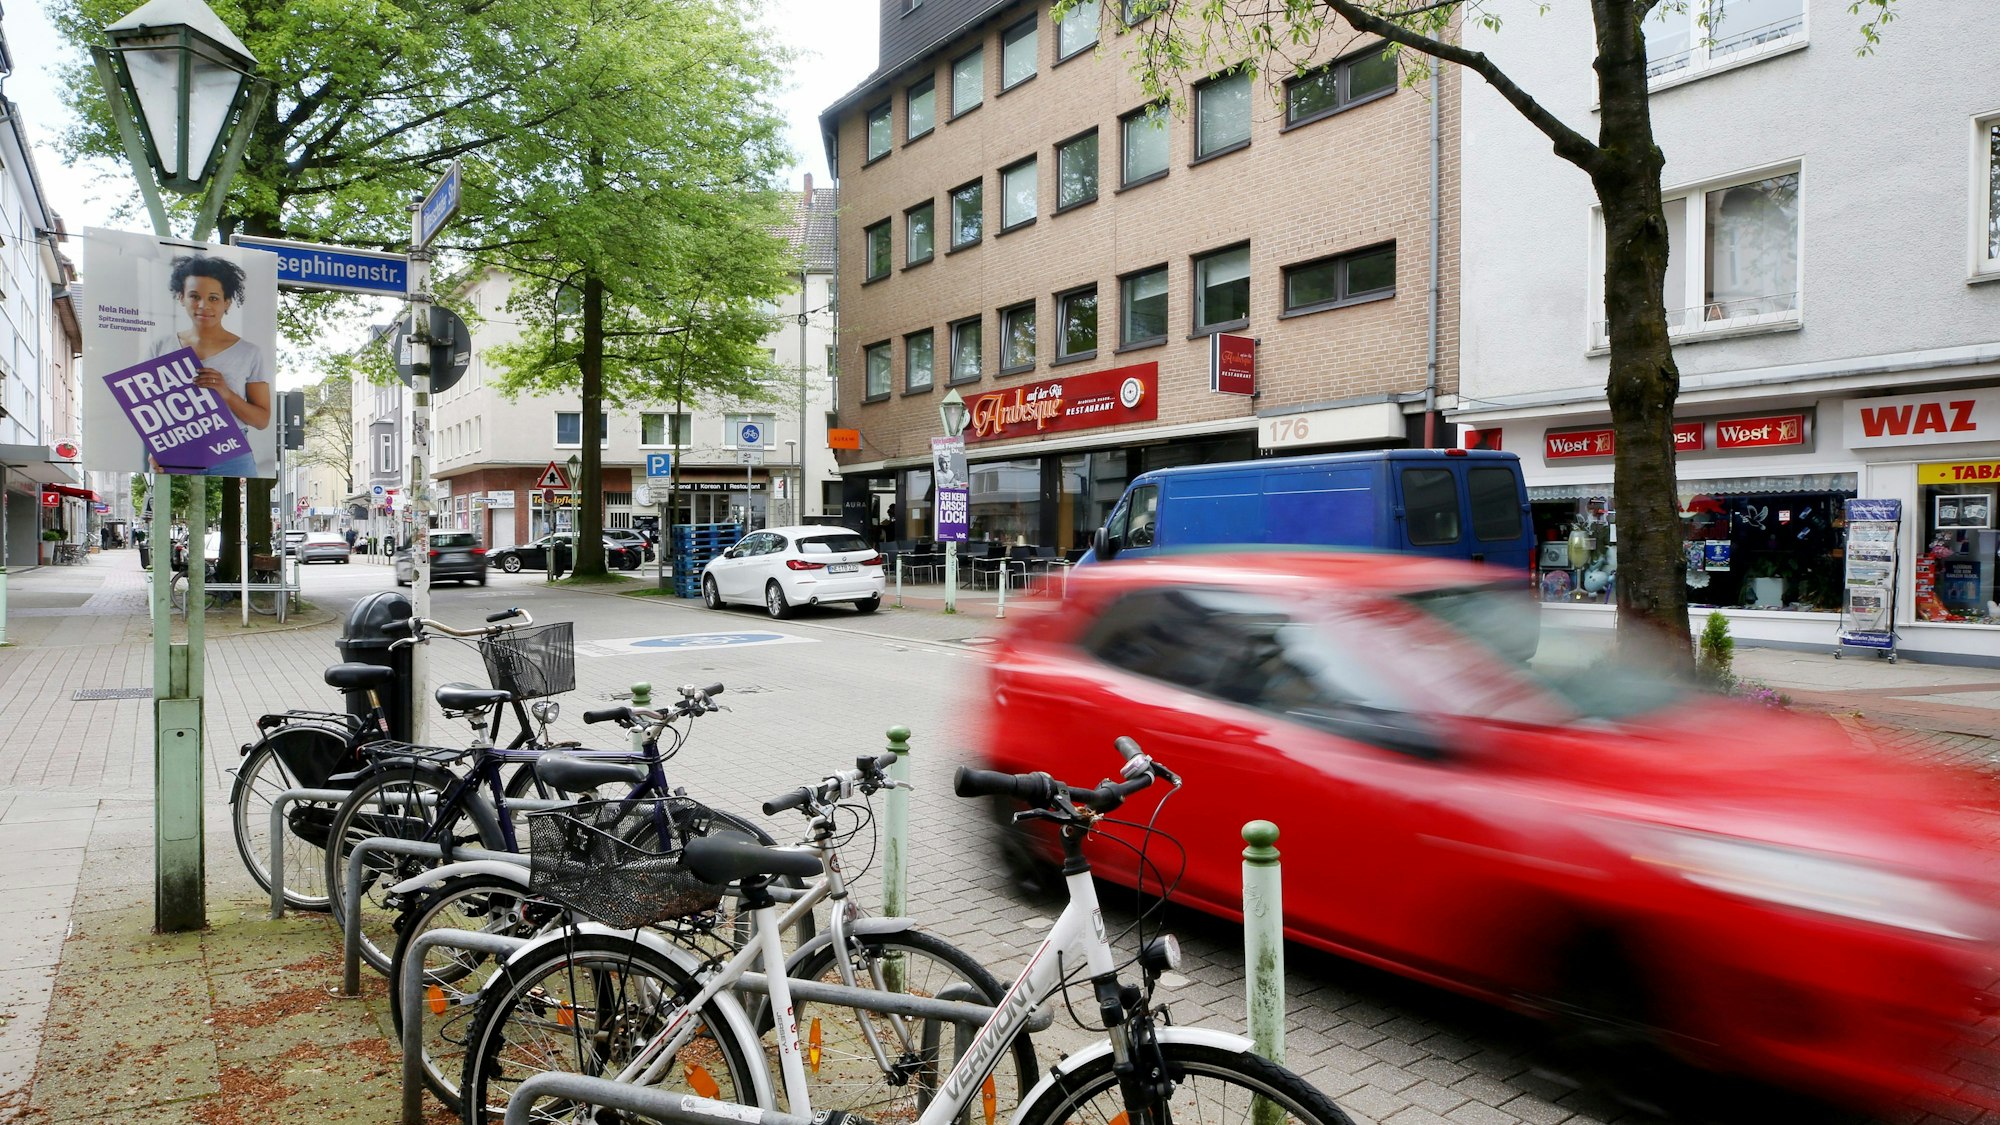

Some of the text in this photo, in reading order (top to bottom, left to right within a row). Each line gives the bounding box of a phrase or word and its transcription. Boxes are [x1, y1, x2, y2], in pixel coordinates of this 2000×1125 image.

[278, 255, 401, 283] sephinenstr.
[98, 305, 139, 316] Nela Riehl
[98, 315, 156, 327] Spitzenkandidatin
[110, 323, 147, 333] Europawahl
[114, 356, 199, 404] TRAU
[1221, 371, 1252, 379] RESTAURANT
[1038, 387, 1049, 400] der
[131, 387, 219, 435] DICH
[972, 388, 1061, 438] Arabesque
[1065, 402, 1115, 416] RESTAURANT
[1860, 399, 1977, 438] WAZ
[149, 413, 229, 453] EUROPA
[1270, 417, 1309, 442] 176
[1719, 423, 1769, 444] West
[209, 437, 241, 455] Volt
[1549, 437, 1590, 454] West
[652, 456, 665, 474] P
[940, 491, 967, 501] SEI KEIN
[940, 501, 967, 511] ARSCH
[940, 511, 967, 524] LOCH
[776, 1011, 788, 1047] JERSEY
[945, 970, 1037, 1101] VERMONT
